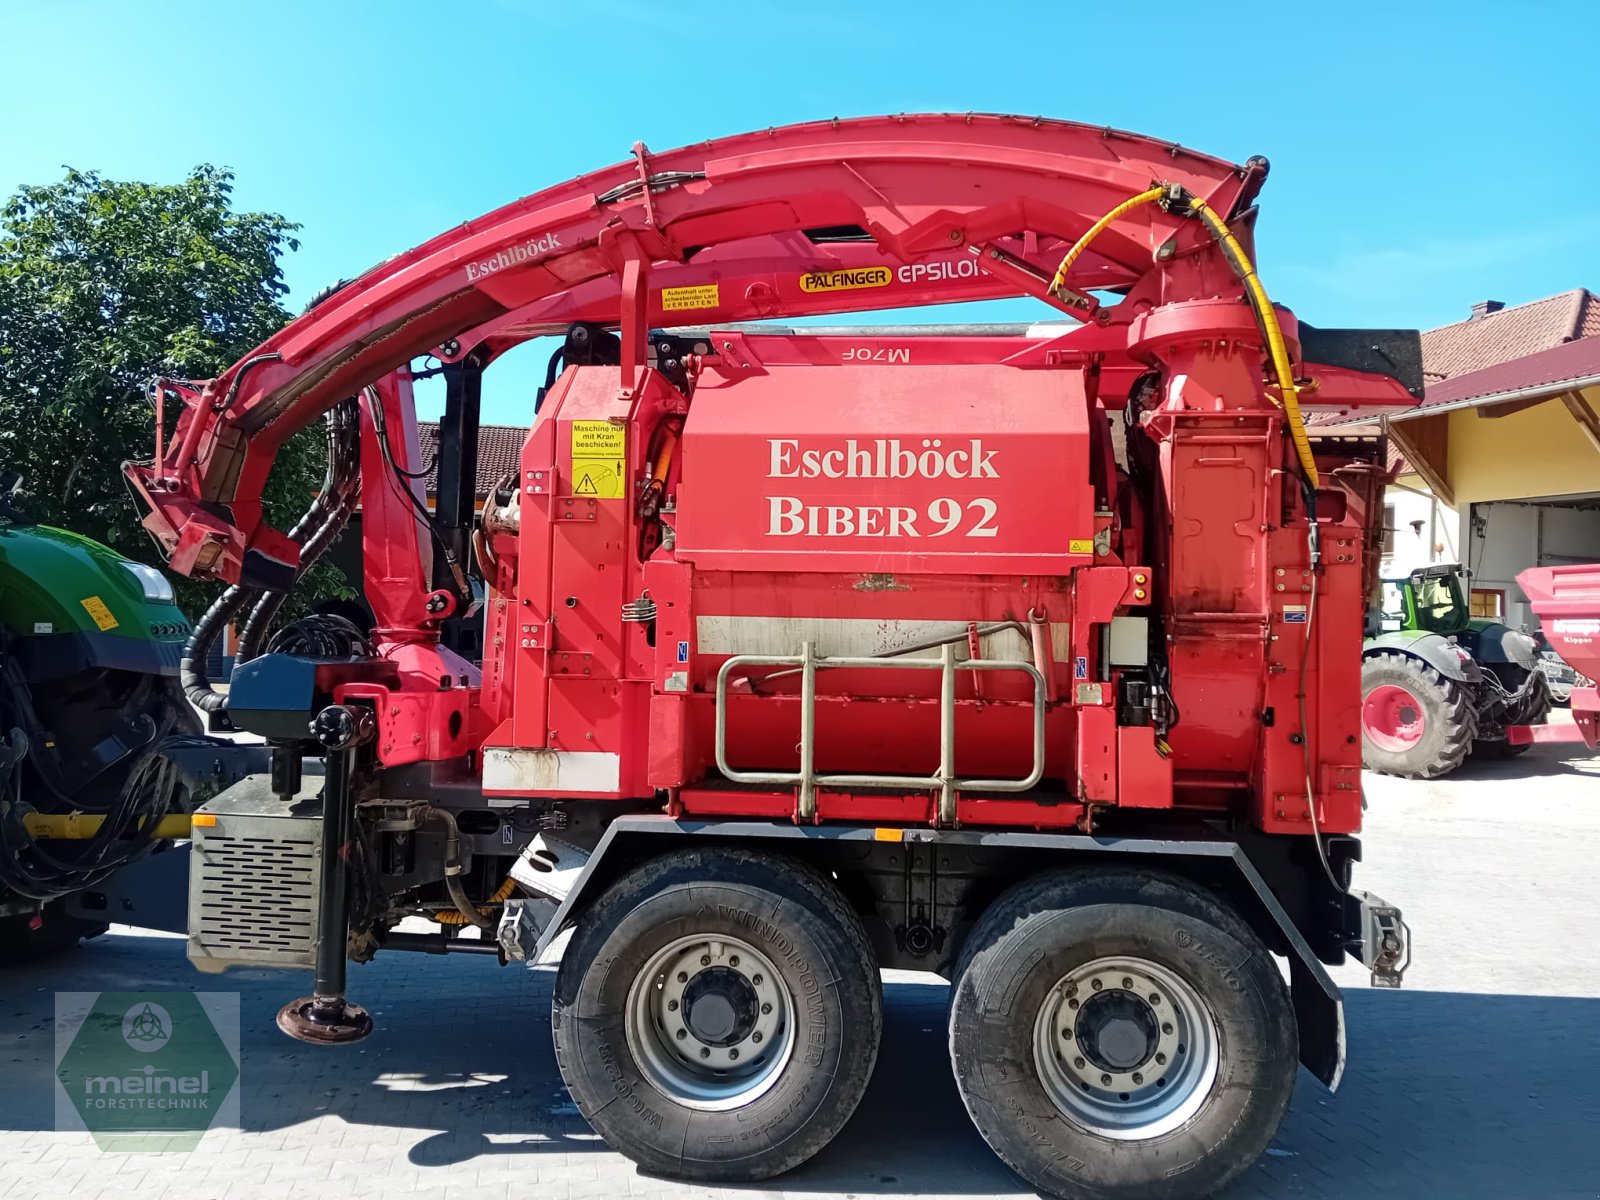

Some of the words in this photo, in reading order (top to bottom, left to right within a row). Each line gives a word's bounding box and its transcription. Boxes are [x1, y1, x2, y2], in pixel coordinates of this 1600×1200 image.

[464, 232, 562, 281] Eschlböck
[805, 270, 886, 289] PALFINGER
[842, 348, 910, 363] M70F
[766, 439, 1001, 478] Eschlböck
[764, 496, 922, 537] BIBER
[927, 497, 999, 538] 92
[718, 904, 827, 1068] WINDPOWER
